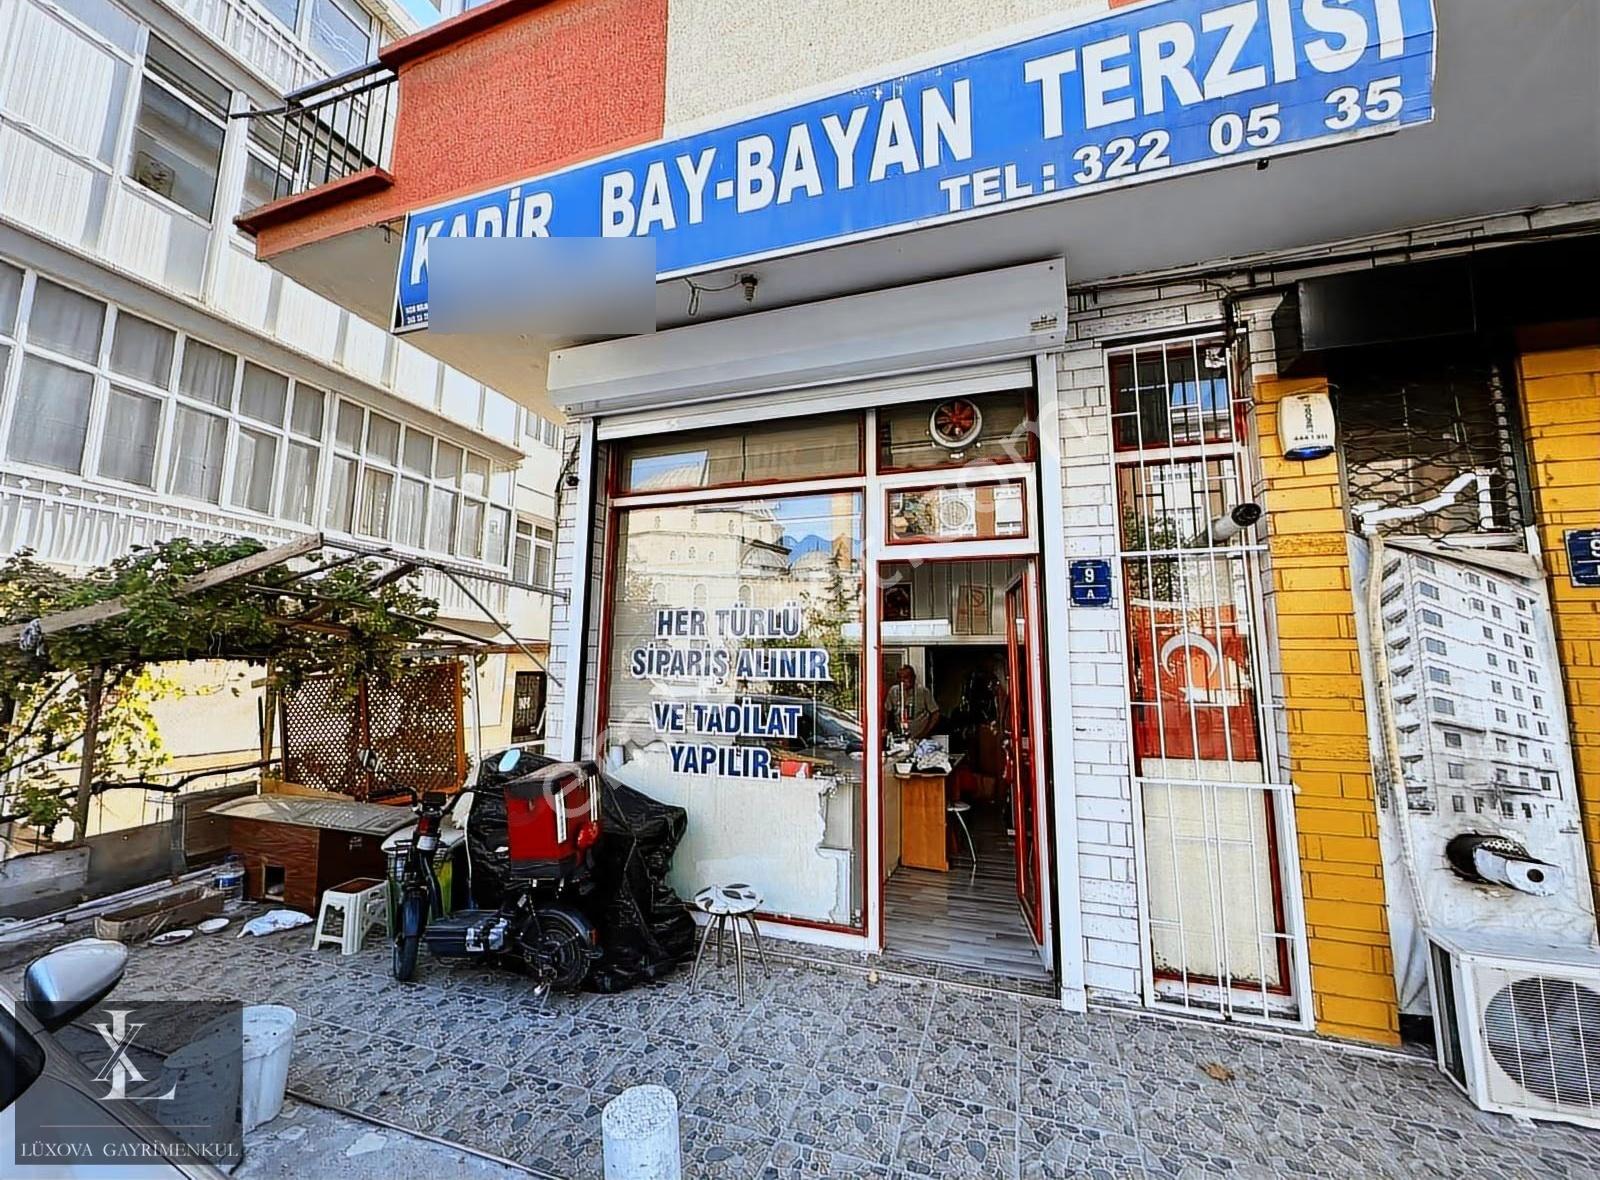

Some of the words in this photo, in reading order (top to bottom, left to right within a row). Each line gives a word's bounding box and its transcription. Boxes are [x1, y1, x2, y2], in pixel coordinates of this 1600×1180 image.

[1072, 130, 1170, 185] 322
[1209, 103, 1281, 154] 05
[1324, 76, 1403, 130] 35
[602, 80, 973, 238] BAY-BAYAN
[1084, 568, 1095, 583] 9
[1087, 588, 1095, 599] A
[657, 609, 706, 636] HER
[715, 602, 800, 636] TÜRLÜ
[632, 643, 730, 685] SİPARİŞ
[736, 649, 828, 679] ALINIR
[654, 703, 685, 731] VE
[694, 698, 801, 736] TADİLAT
[669, 746, 779, 779] YAPILIR.
